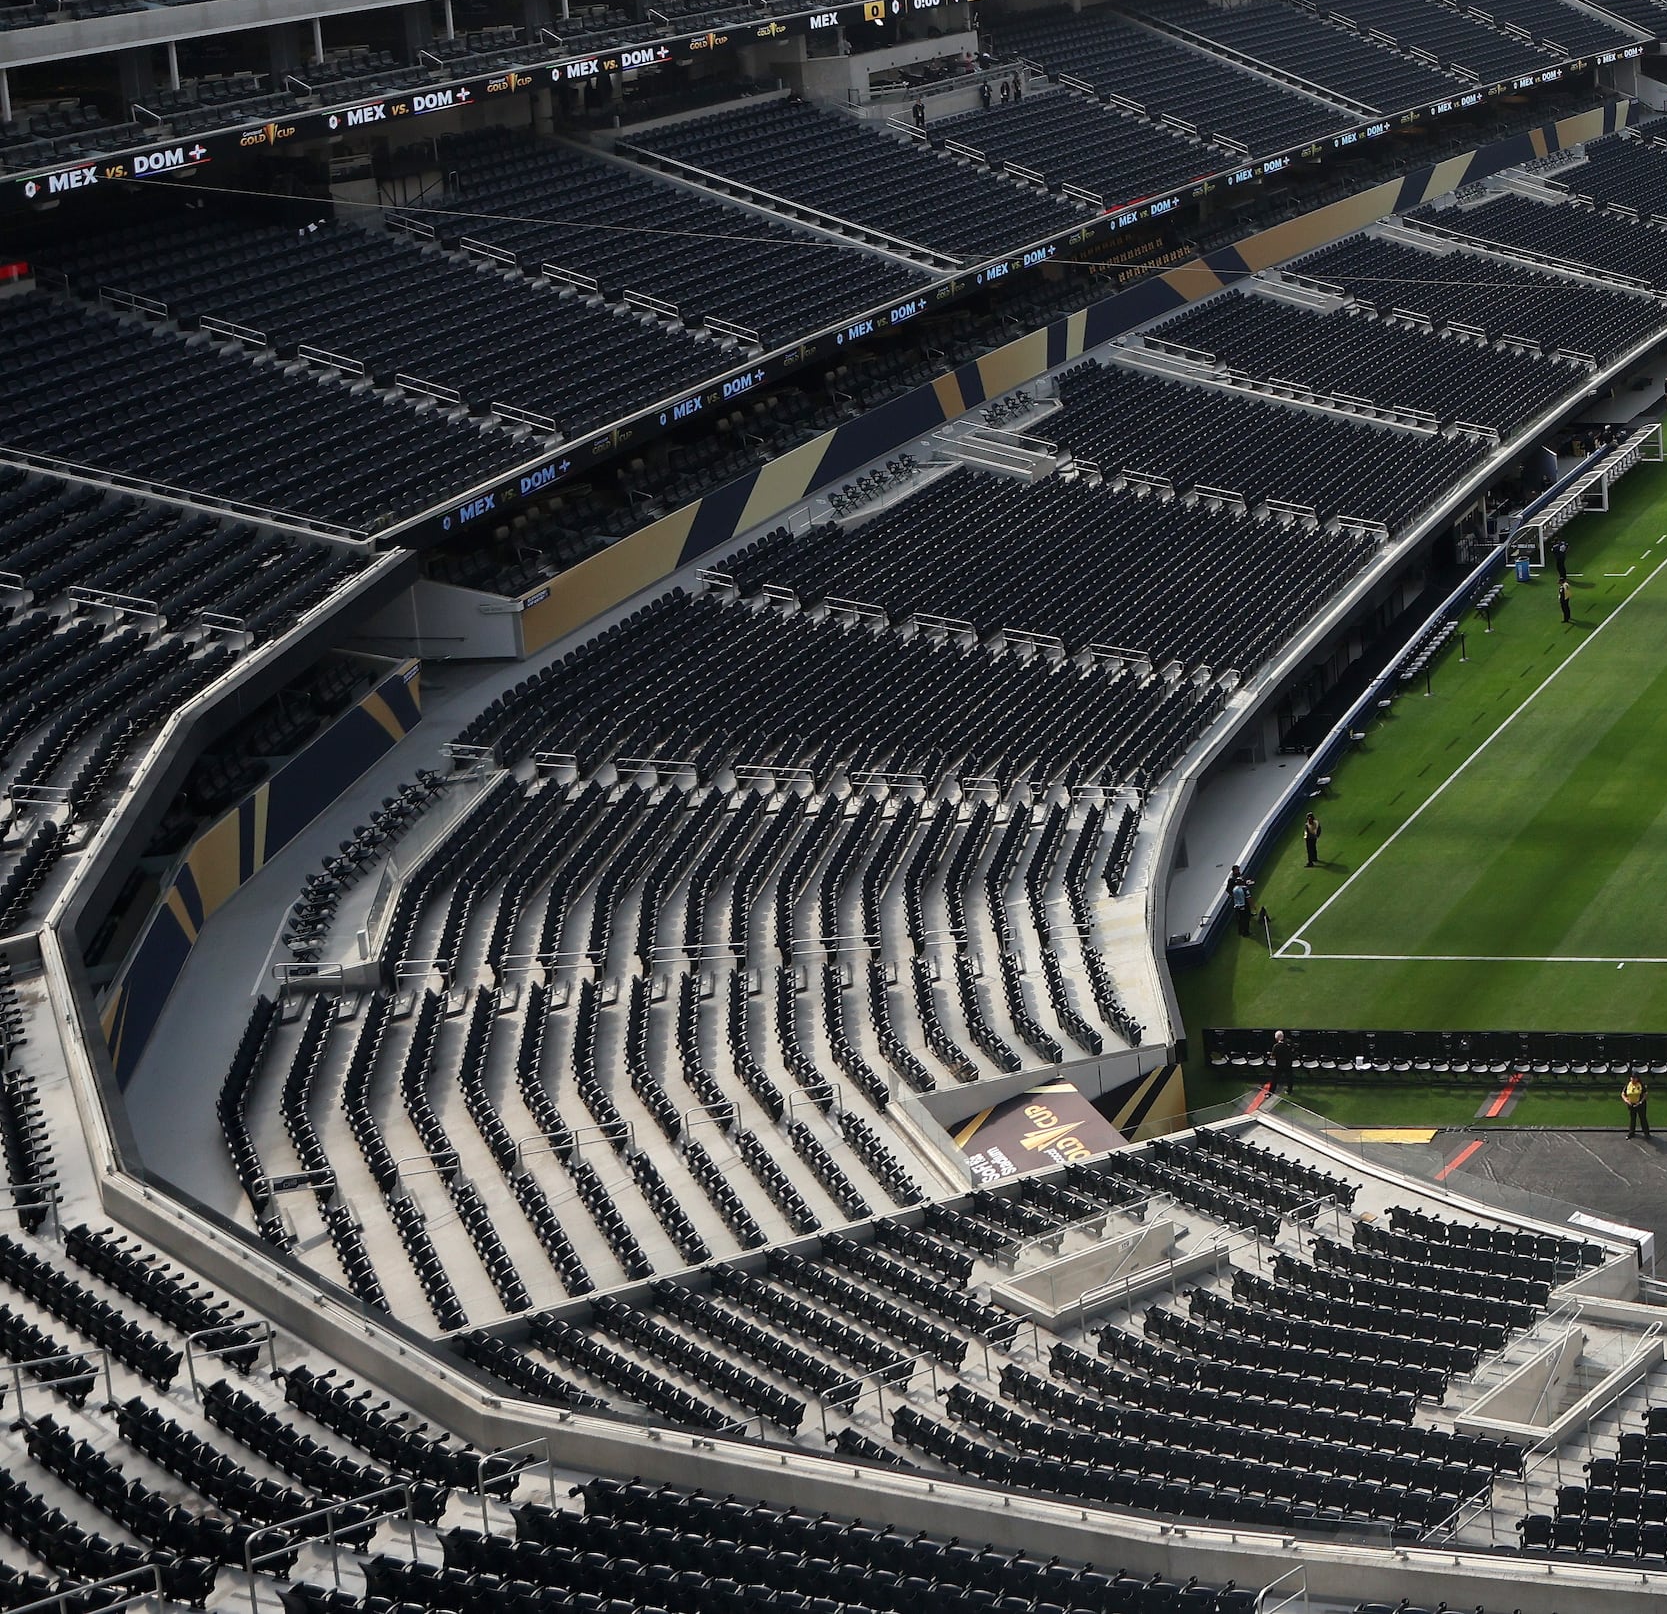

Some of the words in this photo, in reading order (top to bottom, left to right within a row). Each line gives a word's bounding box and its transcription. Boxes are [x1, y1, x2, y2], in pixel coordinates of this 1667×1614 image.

[810, 12, 839, 30] MEX
[567, 59, 599, 79] MEX
[621, 49, 655, 67] DOM
[347, 104, 386, 127] MEX
[413, 90, 453, 111] DOM
[50, 165, 98, 194] MEX
[134, 148, 184, 174] DOM
[986, 262, 1009, 281] MEX
[1023, 246, 1046, 266] DOM
[848, 319, 874, 342] MEX
[890, 301, 916, 323] DOM
[673, 395, 703, 420] MEX
[723, 373, 753, 398] DOM
[459, 493, 495, 524] MEX
[520, 465, 556, 494] DOM
